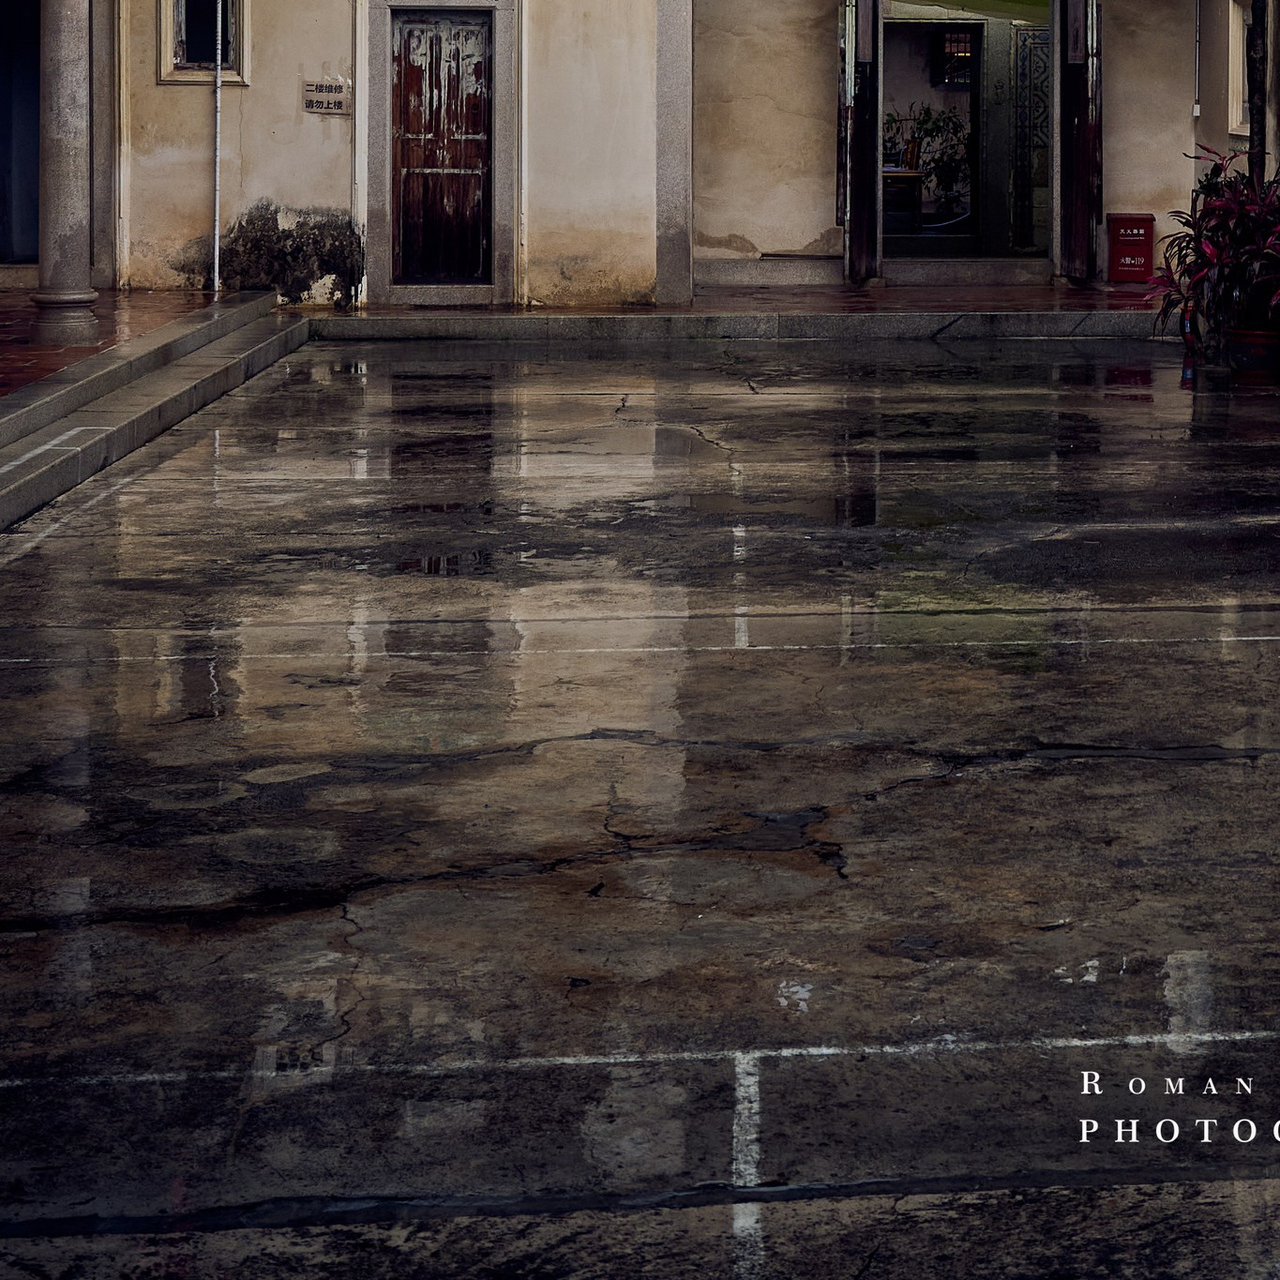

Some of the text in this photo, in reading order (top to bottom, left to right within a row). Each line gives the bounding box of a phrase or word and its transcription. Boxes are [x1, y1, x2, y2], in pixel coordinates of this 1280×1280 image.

[305, 83, 343, 94] 二楼维修
[305, 99, 343, 110] 请勿上楼
